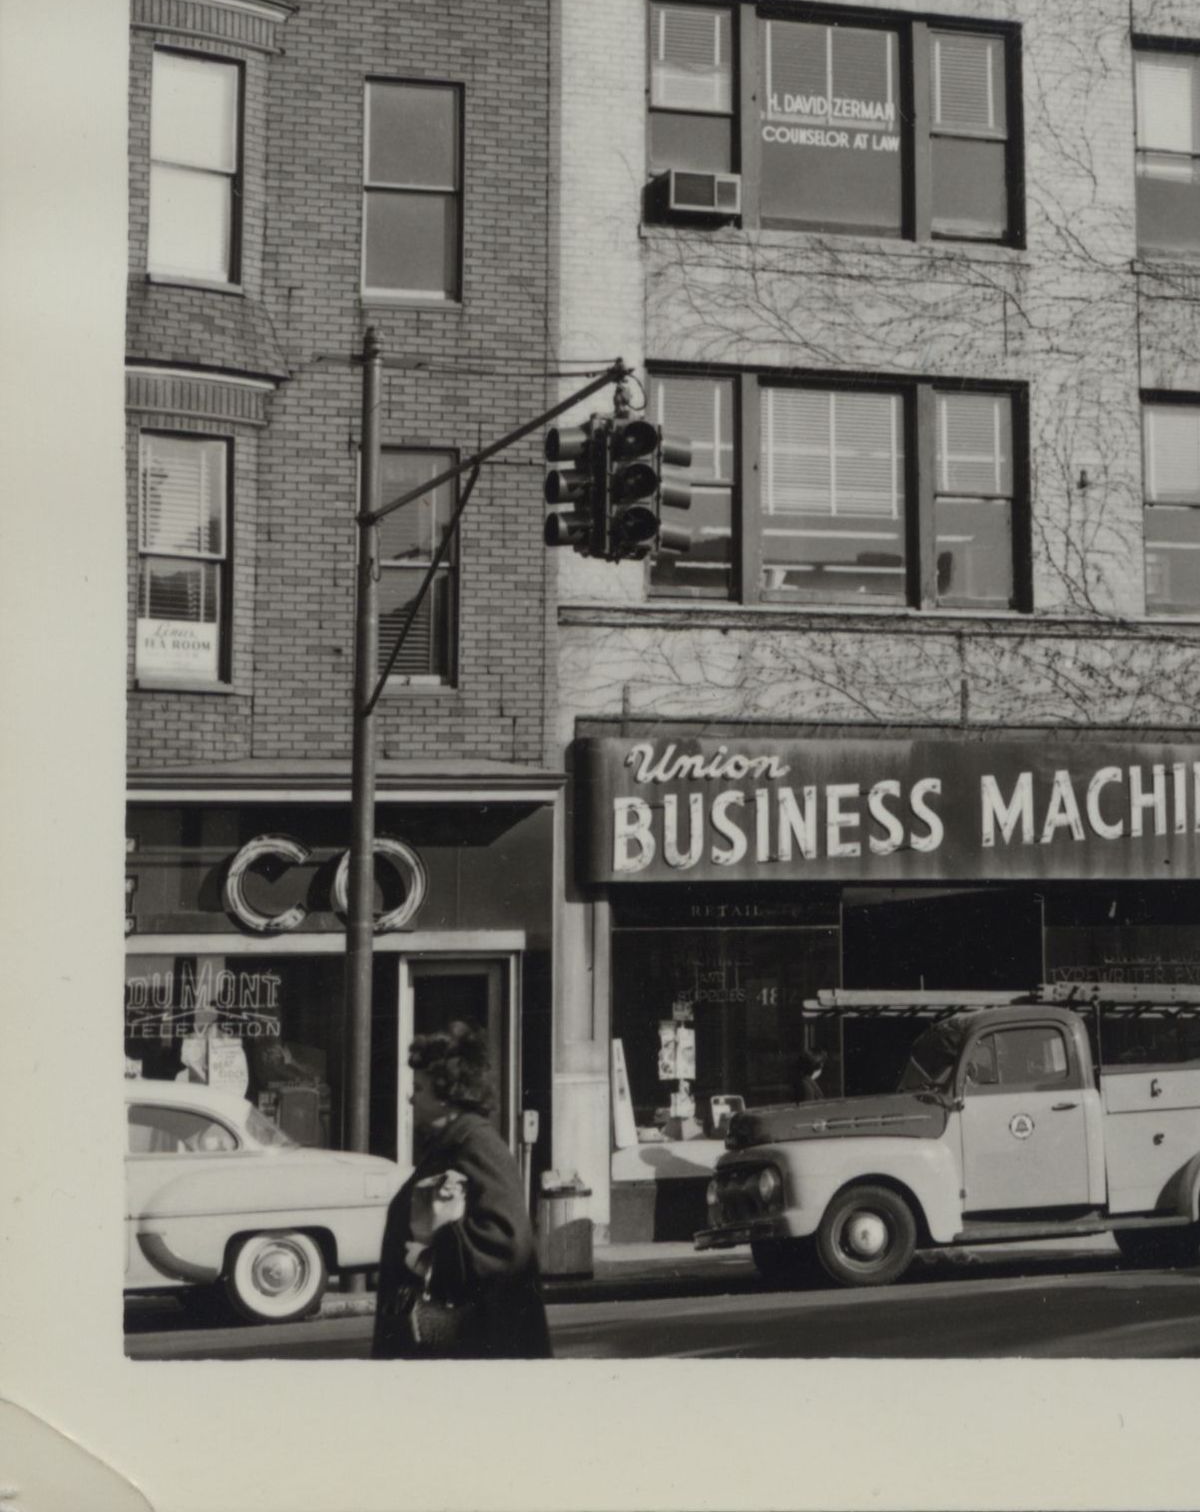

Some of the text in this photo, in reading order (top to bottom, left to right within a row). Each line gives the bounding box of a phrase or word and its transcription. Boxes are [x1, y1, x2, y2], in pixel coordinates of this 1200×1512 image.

[784, 93, 827, 116] DAVID
[762, 125, 900, 152] COUNSELOR AT LAW
[171, 639, 211, 651] ROOM
[625, 742, 790, 784] Union
[612, 778, 944, 873] BUSINESS
[129, 1022, 281, 1038] TELEVISION
